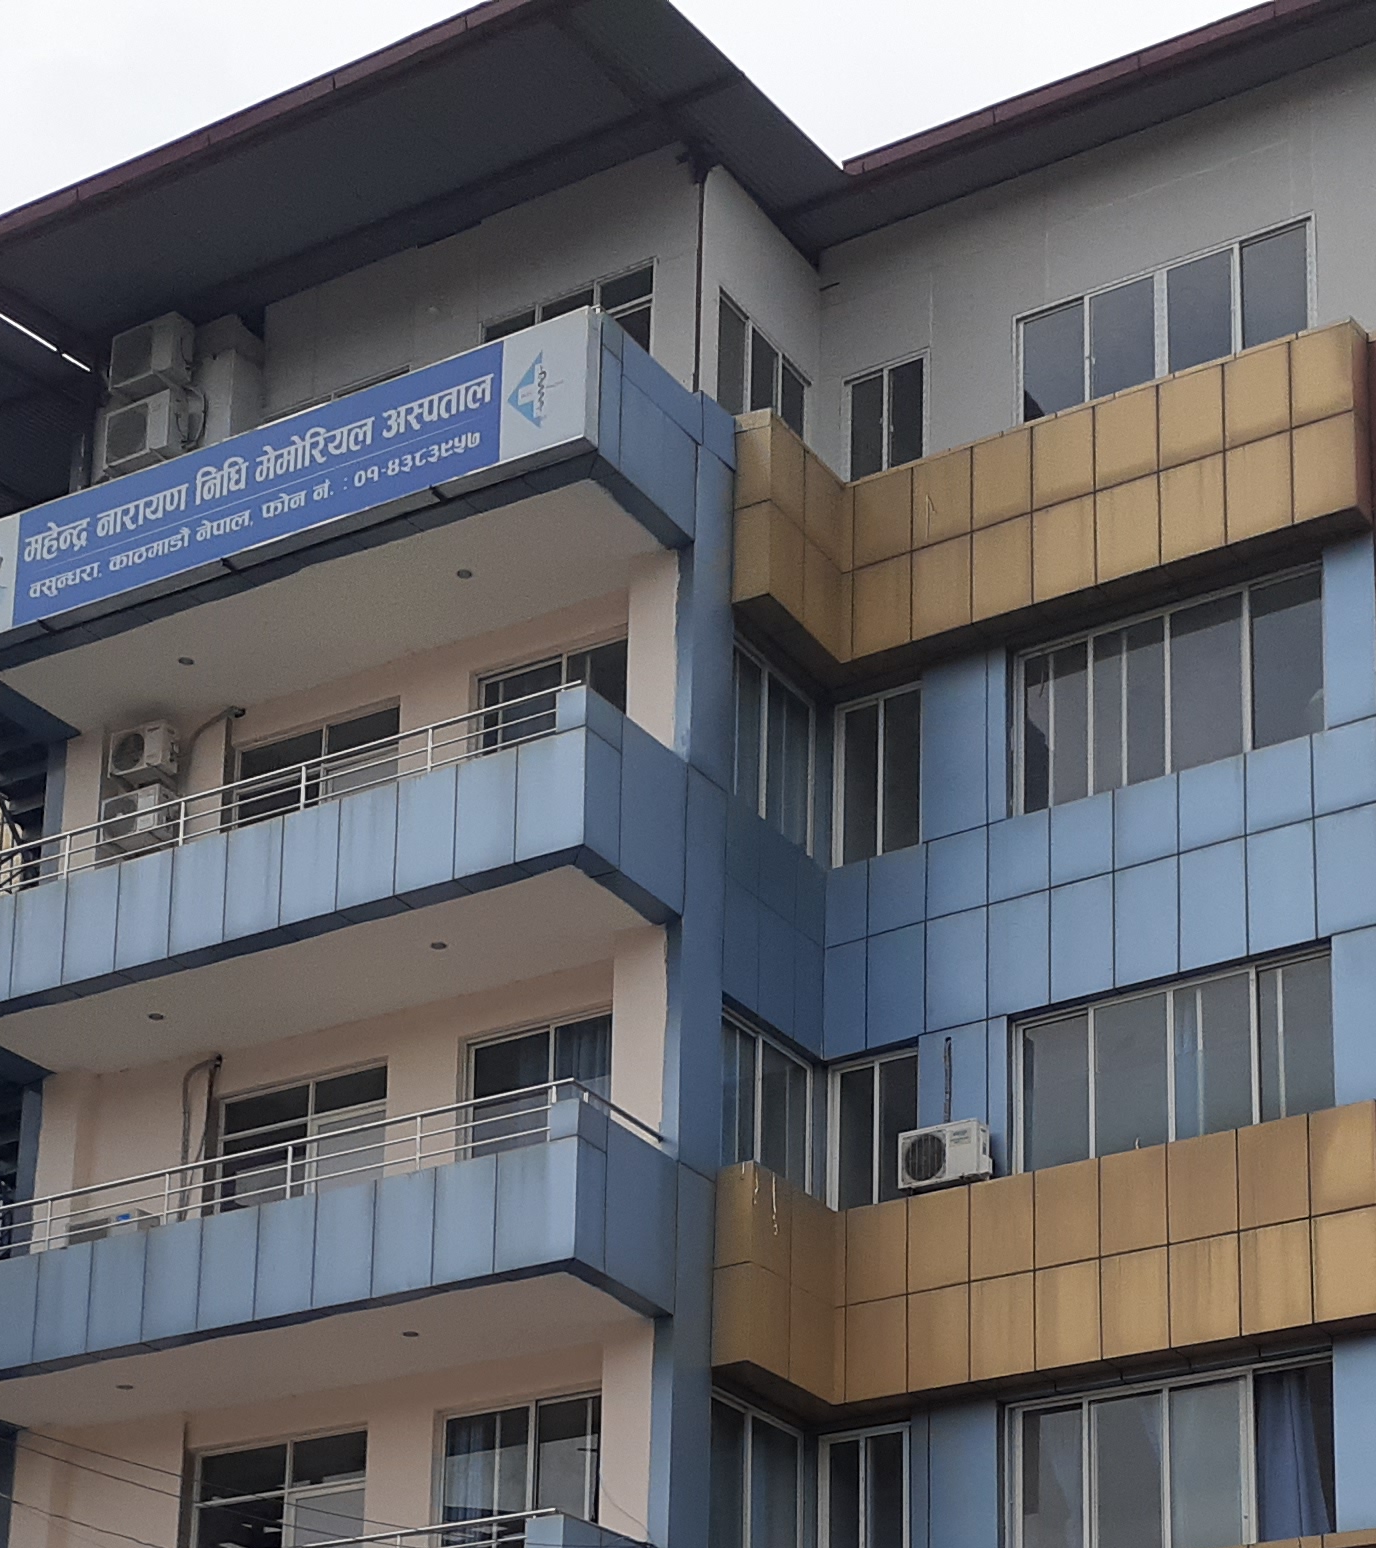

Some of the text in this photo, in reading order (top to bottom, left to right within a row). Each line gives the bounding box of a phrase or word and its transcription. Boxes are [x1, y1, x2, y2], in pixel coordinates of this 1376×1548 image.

[24, 373, 495, 563] महेन्द्र नारायण निधि मेमोरियल अस्पताल
[261, 489, 308, 518] फोन
